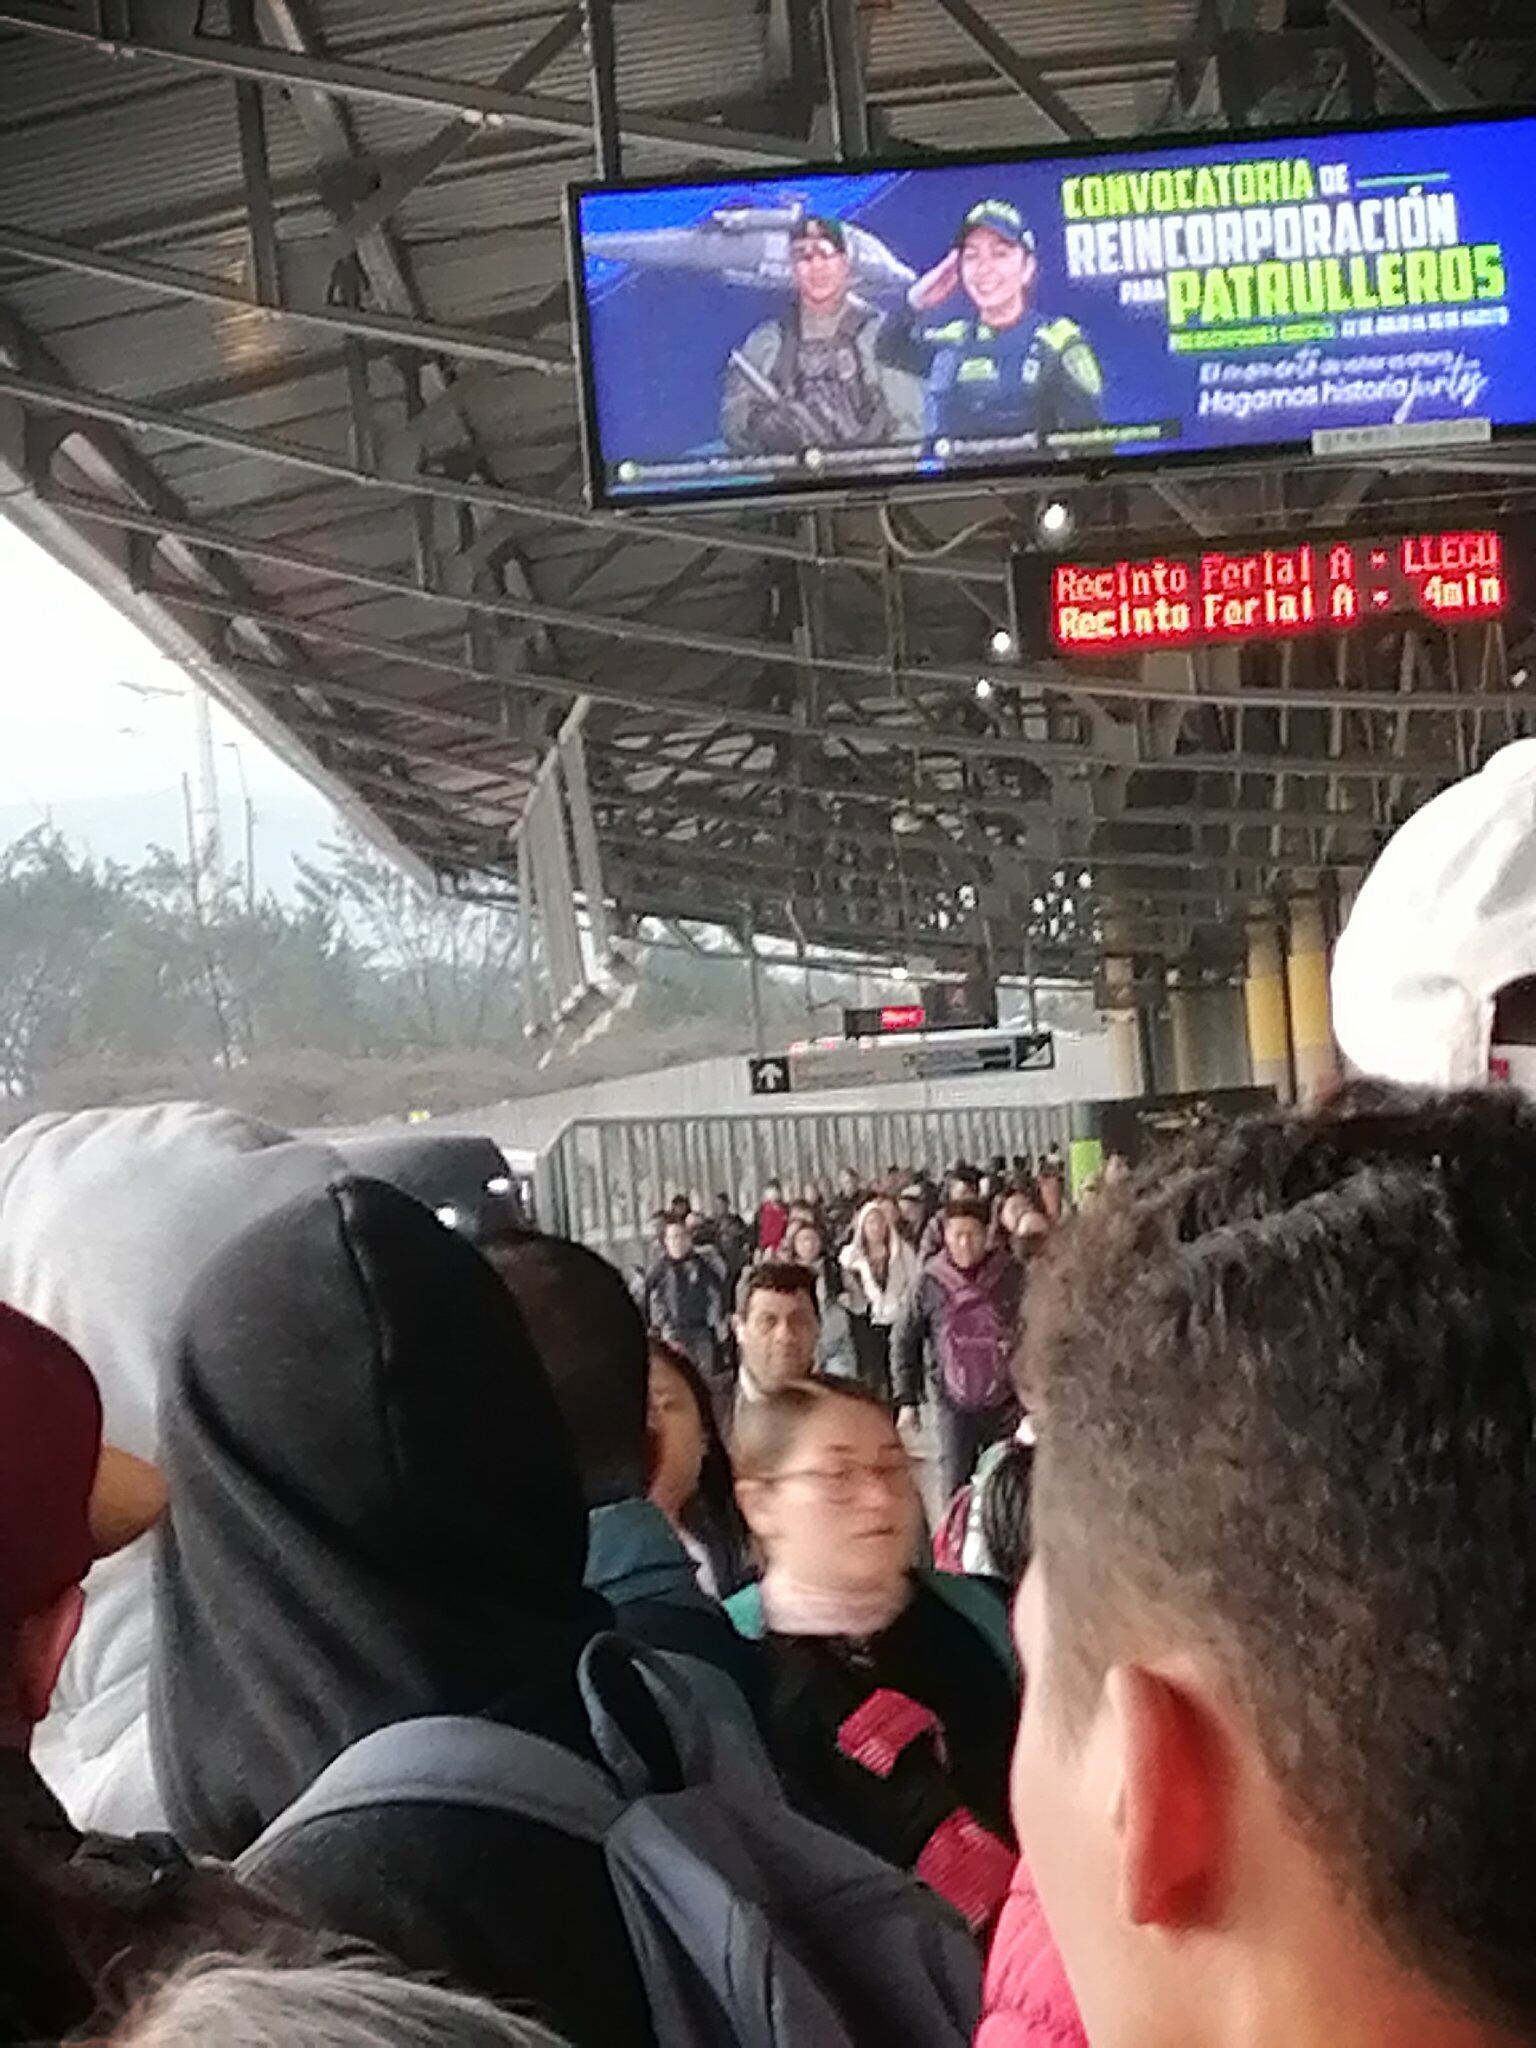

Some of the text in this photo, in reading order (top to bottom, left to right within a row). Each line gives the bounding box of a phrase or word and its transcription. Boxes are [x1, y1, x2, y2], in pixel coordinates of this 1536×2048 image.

[1062, 158, 1350, 219] CONVOCATORIA DE
[1067, 185, 1459, 277] REINCORPORACIÓN
[1168, 244, 1505, 325] PATRULLEROS
[1199, 384, 1318, 417] Hagamos
[1322, 374, 1408, 404] historia
[1057, 563, 1188, 602] Recinto
[1202, 542, 1312, 590] Ferial
[1330, 544, 1352, 580] A
[1058, 600, 1190, 640] Recinto
[1203, 585, 1314, 628] Ferial
[1332, 583, 1355, 617] A
[1425, 574, 1502, 607] 4min
